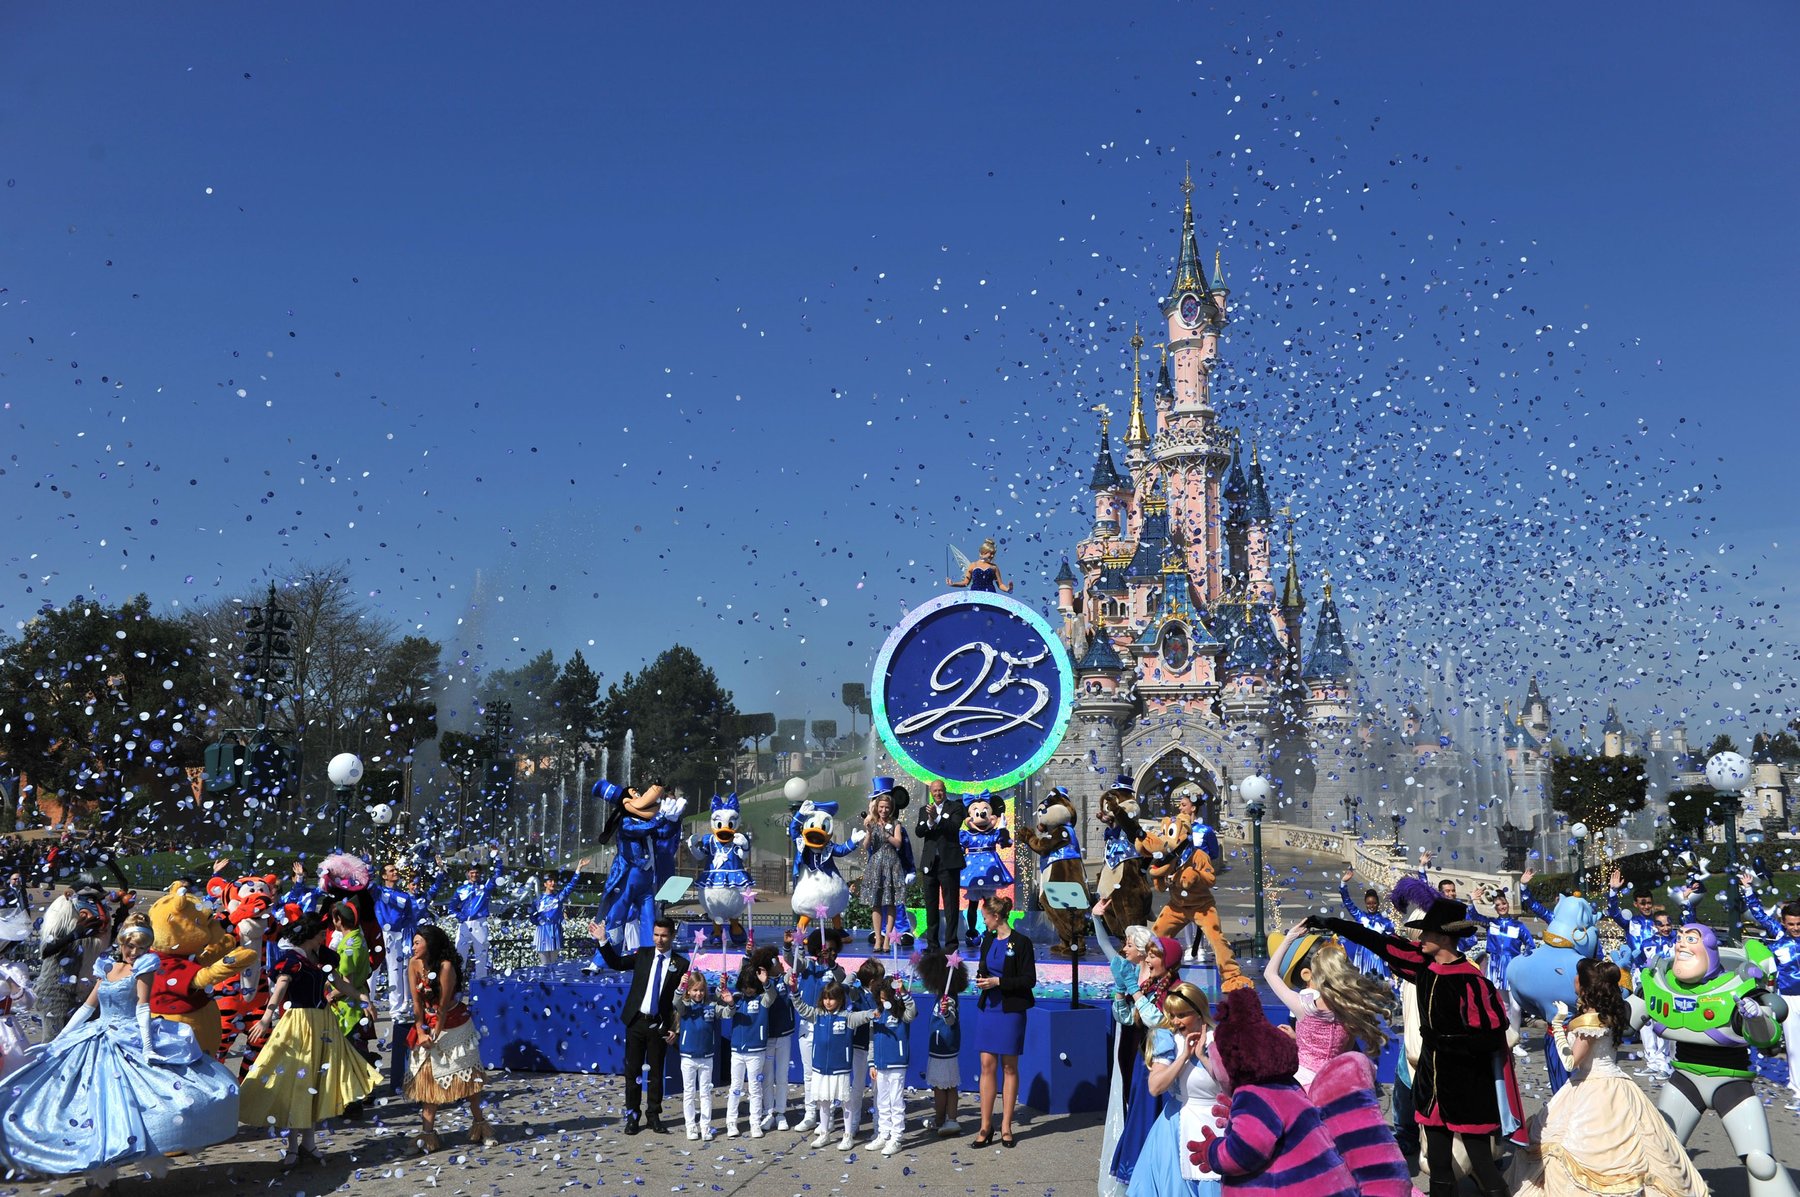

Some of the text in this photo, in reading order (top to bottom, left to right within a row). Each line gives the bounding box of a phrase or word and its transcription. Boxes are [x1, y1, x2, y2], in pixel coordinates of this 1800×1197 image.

[894, 641, 1048, 743] 25
[747, 1000, 759, 1010] 25
[703, 1008, 715, 1018] 25
[833, 1020, 846, 1031] 25
